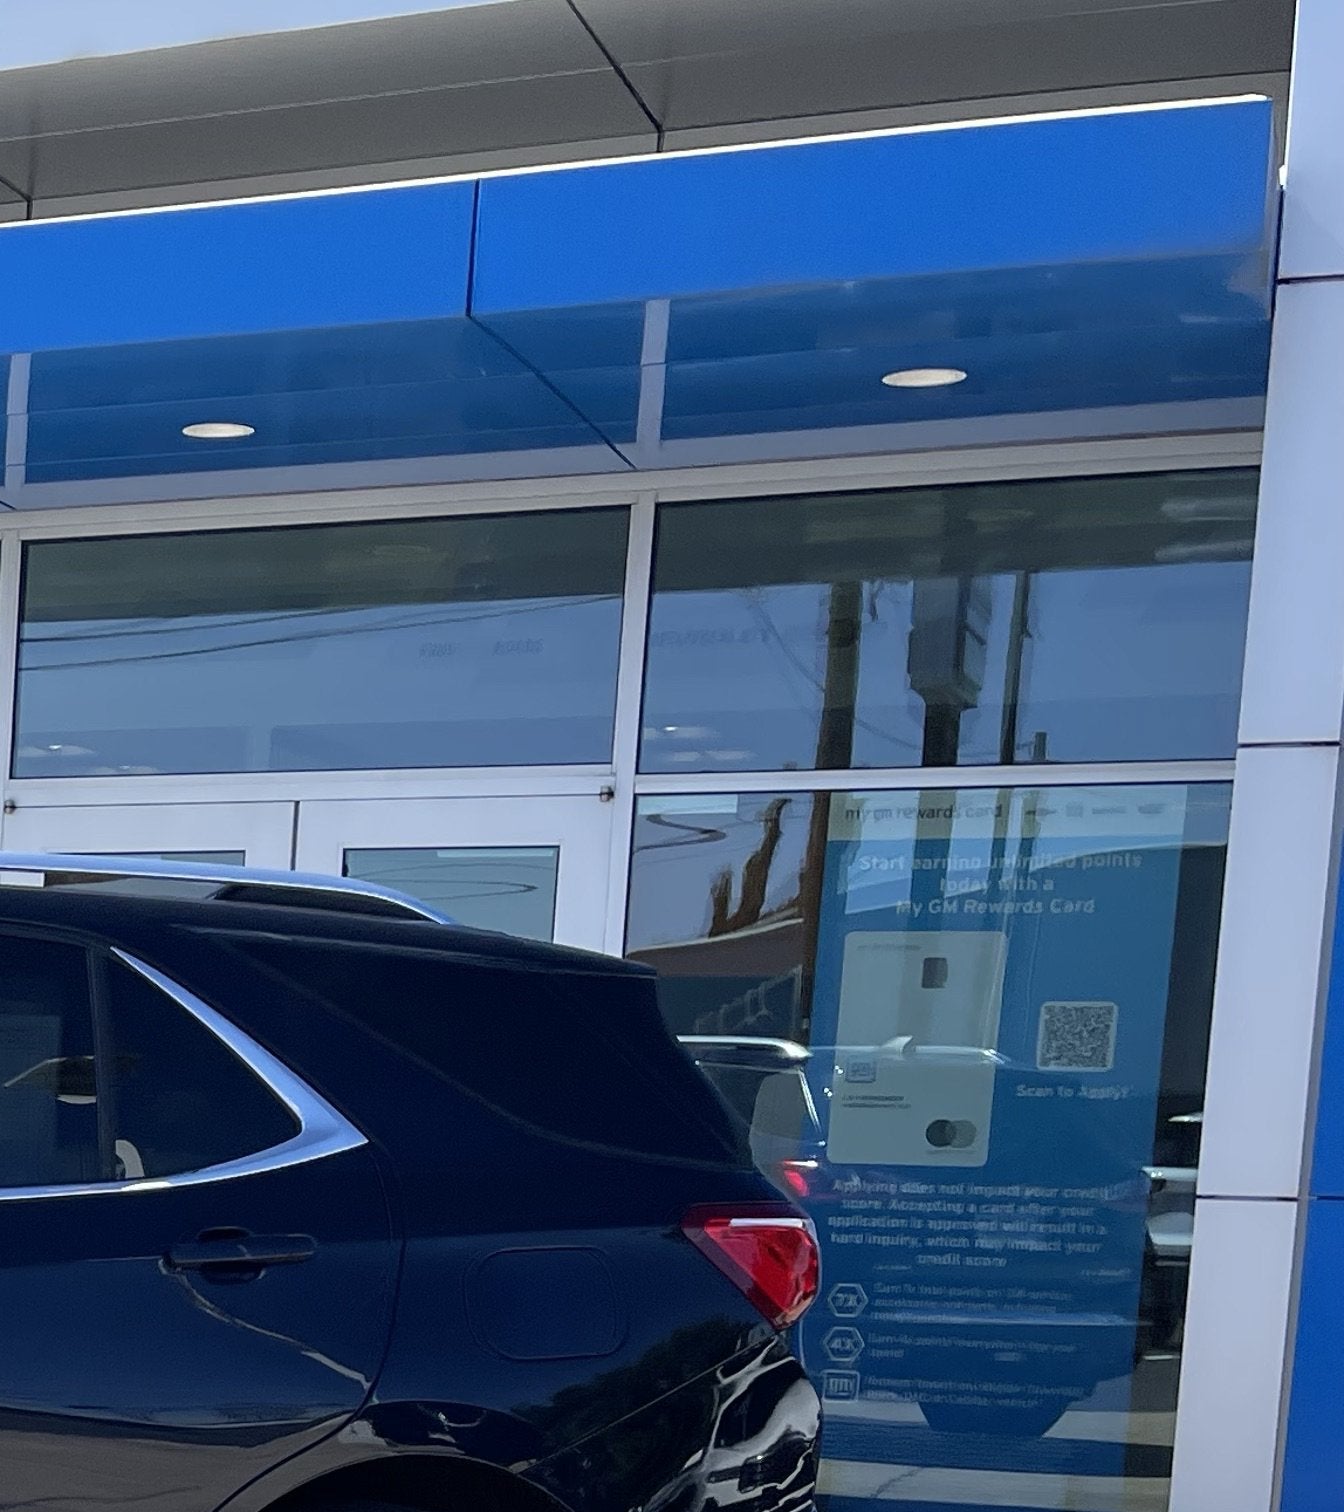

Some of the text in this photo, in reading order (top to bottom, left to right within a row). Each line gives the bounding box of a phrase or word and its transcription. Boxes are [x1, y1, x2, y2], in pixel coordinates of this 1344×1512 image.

[964, 804, 1003, 819] card
[859, 855, 905, 871] Start
[1082, 852, 1143, 870] points
[940, 876, 993, 895] today
[1042, 879, 1055, 891] a
[928, 898, 958, 915] GM
[964, 898, 1044, 915] Rewards
[1049, 898, 1096, 915] Card
[1016, 1084, 1053, 1097] Scan
[1056, 1085, 1074, 1098] to
